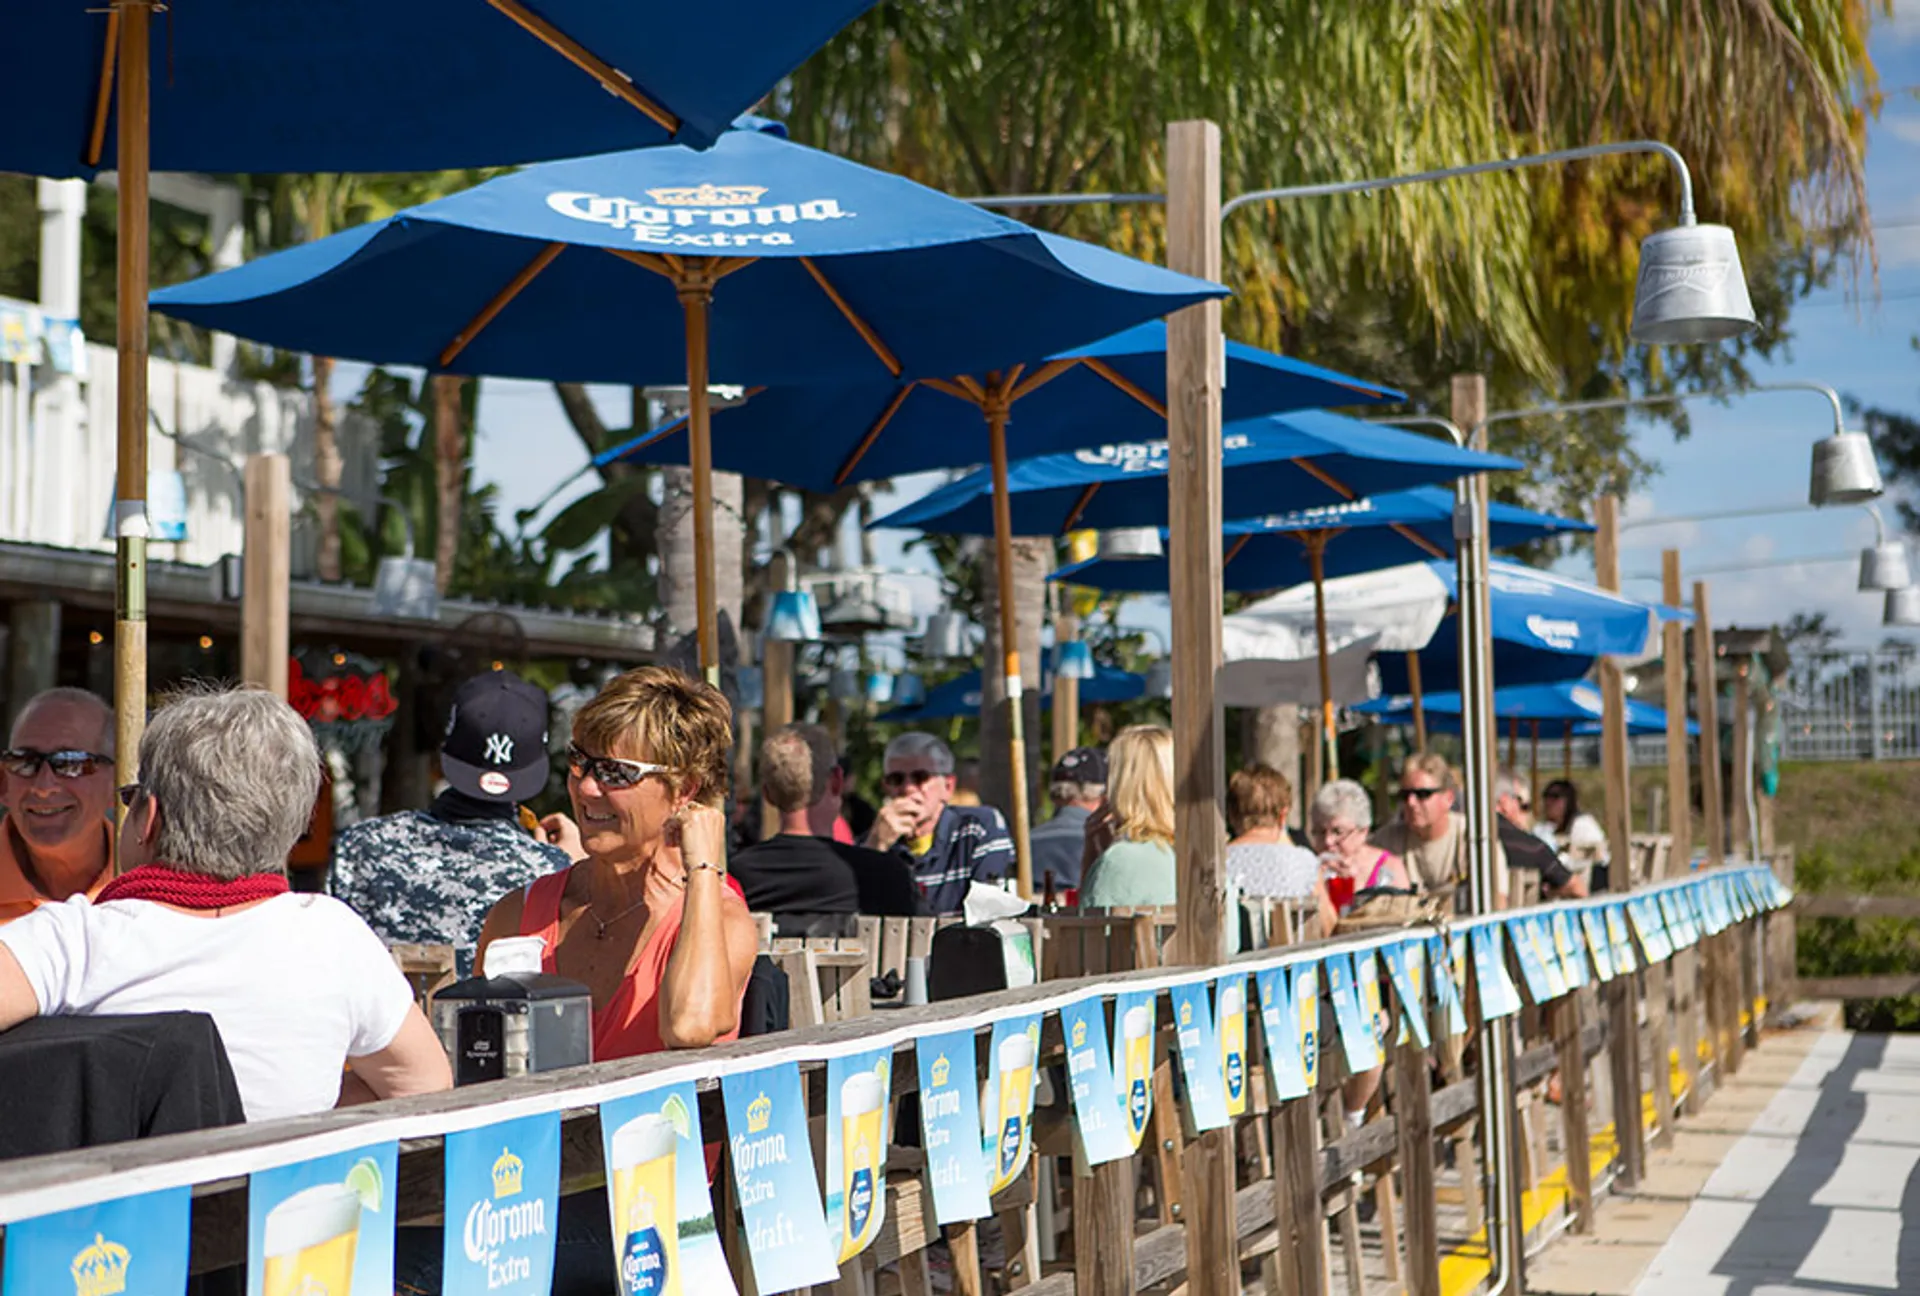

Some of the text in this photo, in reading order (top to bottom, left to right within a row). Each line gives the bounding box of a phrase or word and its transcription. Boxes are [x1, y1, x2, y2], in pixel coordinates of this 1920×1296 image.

[546, 191, 852, 228] Corona
[632, 224, 794, 246] Extra
[1075, 435, 1250, 466] Cora
[484, 732, 514, 764] NY
[464, 1198, 548, 1267] Corona
[487, 1249, 530, 1290] Extra
